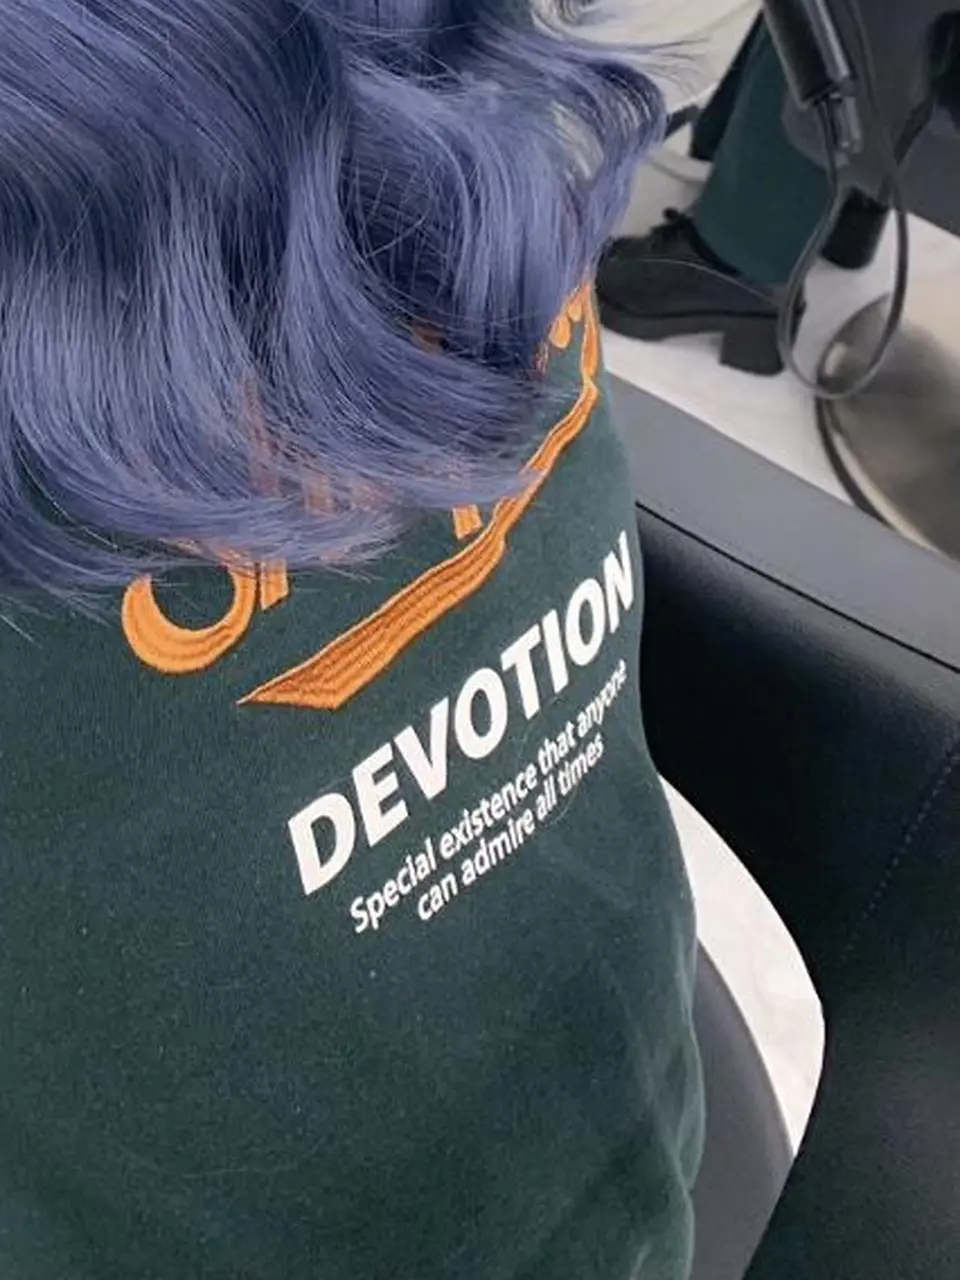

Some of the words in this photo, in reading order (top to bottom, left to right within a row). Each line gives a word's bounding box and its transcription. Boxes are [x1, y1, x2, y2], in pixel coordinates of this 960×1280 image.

[288, 530, 634, 896] DEVOTION
[350, 836, 437, 933] Special
[440, 763, 538, 861] existence
[538, 721, 576, 775] that
[576, 658, 628, 738] anyone
[417, 873, 459, 921] can
[461, 808, 536, 886] admire
[535, 777, 558, 821] all
[558, 733, 605, 796] times
